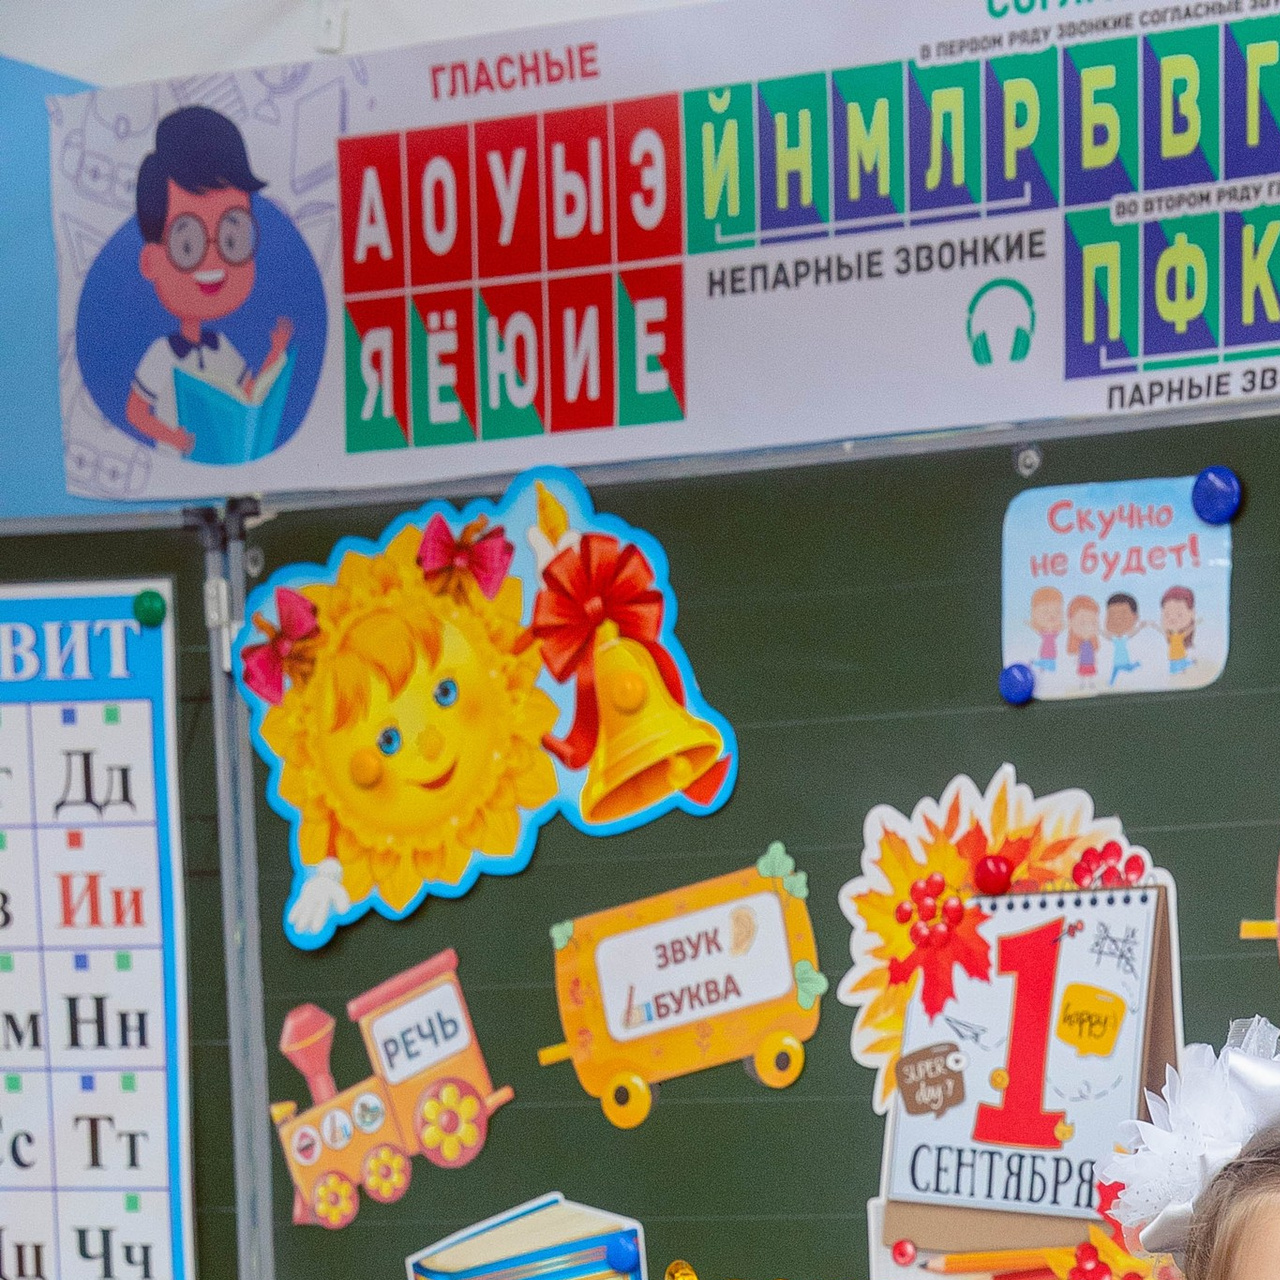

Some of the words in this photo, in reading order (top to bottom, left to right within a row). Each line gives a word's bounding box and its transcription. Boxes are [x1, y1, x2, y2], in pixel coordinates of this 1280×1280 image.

[1007, 26, 1051, 47] РЯДУ
[1057, 13, 1134, 40] ЗВОНКИЕ
[430, 42, 599, 100] ГЛАСНЫЕ
[1144, 190, 1210, 213] ВТОРОМ
[1216, 183, 1263, 203] РЯДУ
[707, 250, 884, 298] НЕПАРНЫЕ
[895, 229, 1046, 276] ЗВОНКИЕ
[1107, 372, 1231, 410] ПАРНЫЕ
[1047, 499, 1174, 540] Скучно
[1030, 552, 1069, 579] не
[1080, 533, 1201, 582] будет!
[54, 749, 137, 820] Дд
[55, 871, 146, 929] Ии
[654, 928, 722, 969] ЗВУК
[61, 994, 149, 1050] Нн
[654, 974, 741, 1018] БУКВА
[384, 1011, 458, 1069] РЕЧЬ
[972, 917, 1069, 1150] 1
[73, 1113, 149, 1169] Тт
[910, 1143, 1097, 1209] СЕНТЯБРЯ
[74, 1226, 152, 1280] Чч
